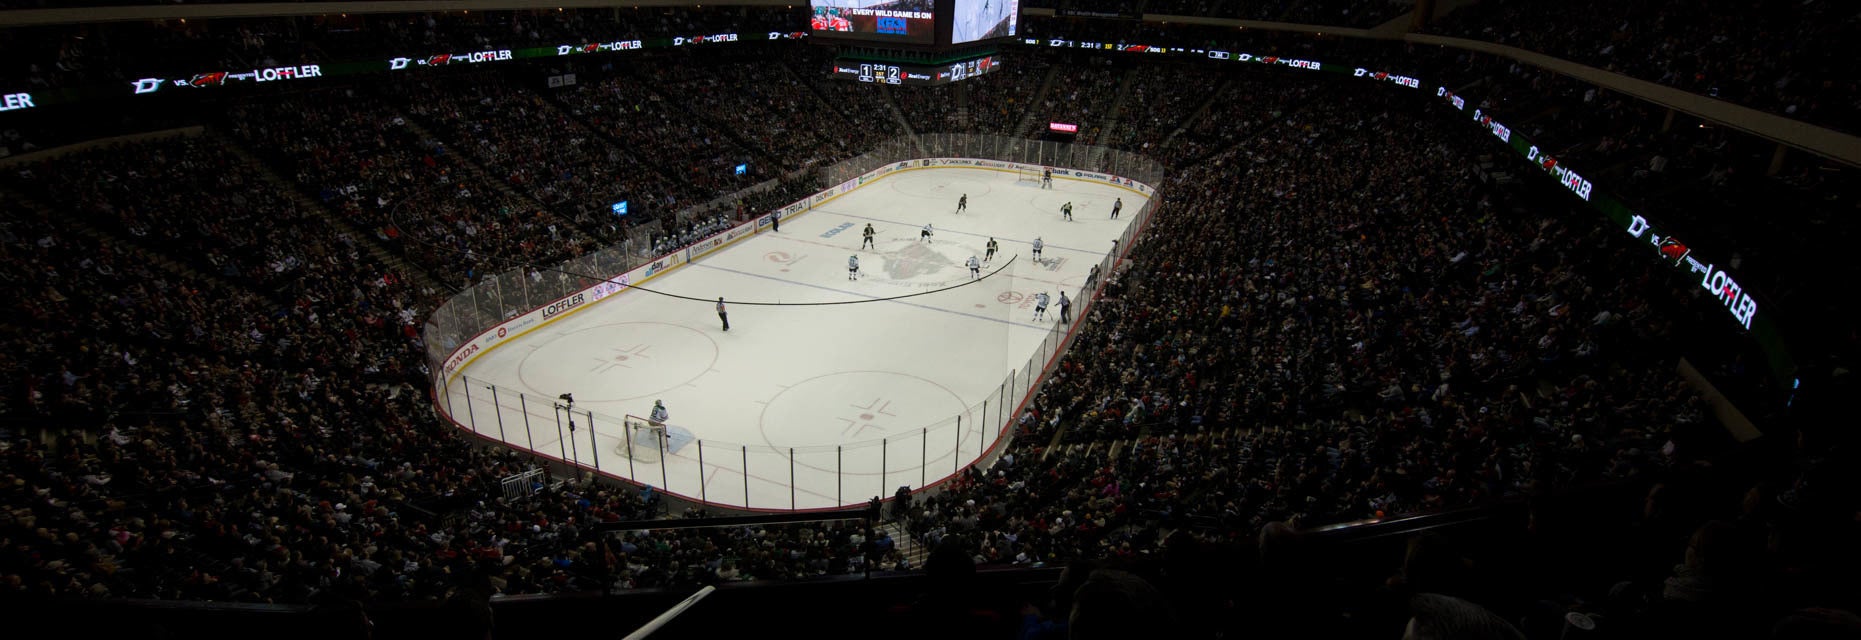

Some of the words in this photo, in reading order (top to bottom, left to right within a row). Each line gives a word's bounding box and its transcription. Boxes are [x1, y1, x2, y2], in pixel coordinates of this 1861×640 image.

[852, 8, 875, 16] EVERY
[875, 9, 892, 17] WILD
[893, 10, 913, 18] GAME
[914, 11, 921, 19] IS
[921, 12, 932, 20] ON
[712, 34, 738, 43] LOFFLER
[611, 40, 642, 51] LOFFLER
[468, 50, 512, 63] LOFFLER
[863, 66, 869, 76] 1
[1288, 58, 1321, 71] LOFFLER
[253, 65, 322, 83] LOFFLER
[890, 68, 898, 78] 2
[1395, 75, 1420, 89] LOFFLER
[1560, 167, 1592, 202] LOFFLER
[784, 202, 803, 216] TRIA
[1701, 263, 1758, 331] LOFFLER
[542, 293, 585, 318] LOFFLER
